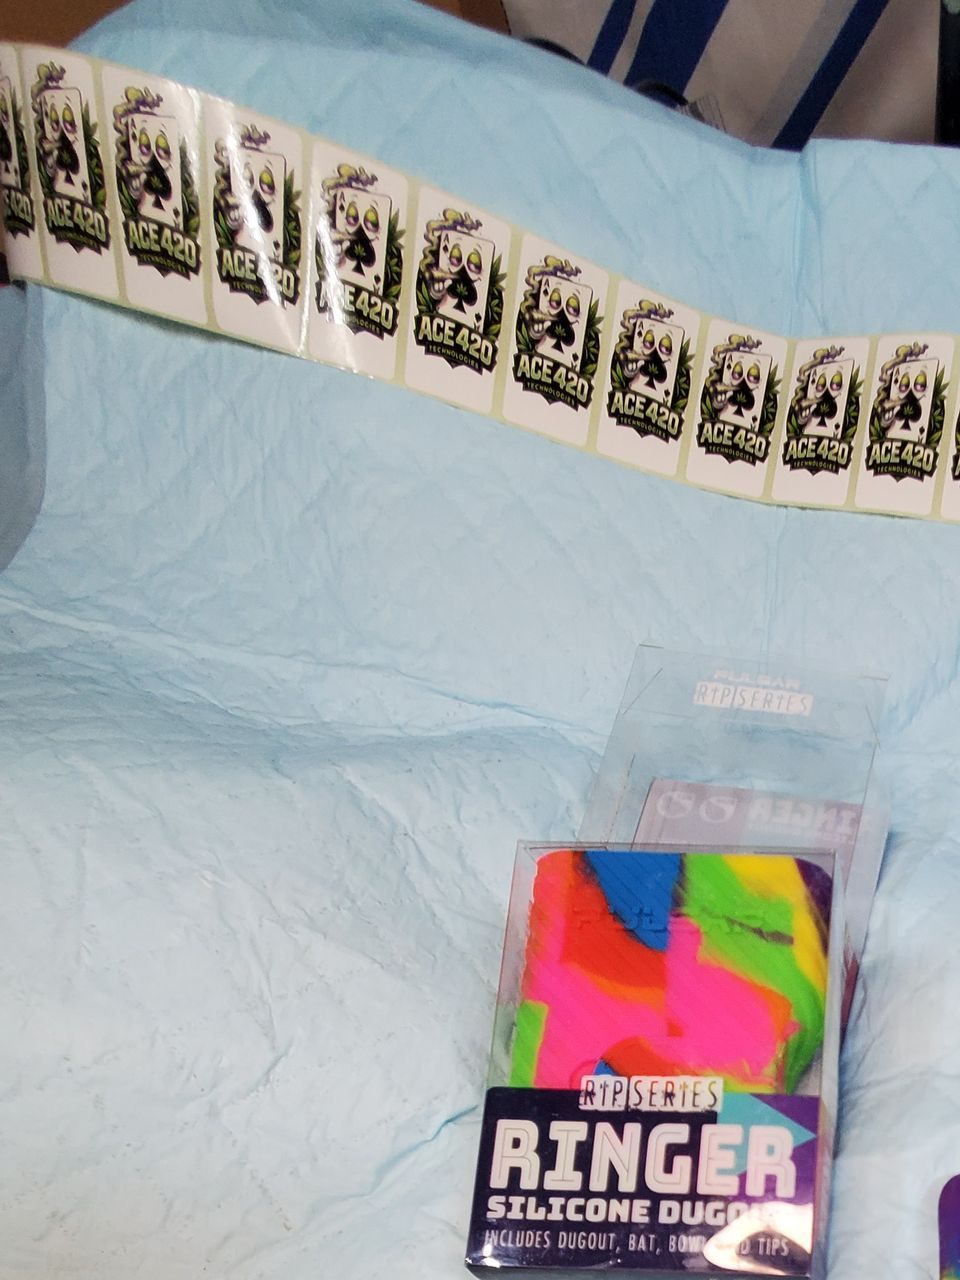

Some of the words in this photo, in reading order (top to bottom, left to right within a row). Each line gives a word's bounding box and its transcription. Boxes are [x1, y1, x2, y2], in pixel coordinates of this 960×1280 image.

[46, 197, 73, 229] ACE
[73, 202, 107, 243] 420
[128, 220, 160, 250] ACE
[160, 226, 197, 268] 420
[221, 249, 257, 280] ACE
[355, 290, 393, 330] 420
[418, 315, 455, 347] ACE
[455, 326, 493, 366] 420
[428, 345, 479, 368] TECHNOLOGIES
[517, 354, 552, 384] ACE
[552, 369, 590, 404] 420
[610, 391, 645, 419] ACE
[645, 402, 681, 437] 420
[700, 422, 734, 447] ACE
[733, 429, 768, 459] 420
[785, 437, 817, 460] ACE
[816, 439, 849, 466] 420
[868, 441, 902, 466] ACE
[901, 443, 934, 474] 420
[489, 1118, 797, 1199] RINGER
[486, 1195, 652, 1224] SILICONE
[484, 1229, 550, 1249] INCLUDES
[558, 1231, 622, 1254] DUGOUT,
[628, 1233, 662, 1256] BAT,
[758, 1238, 790, 1257] TIPS
